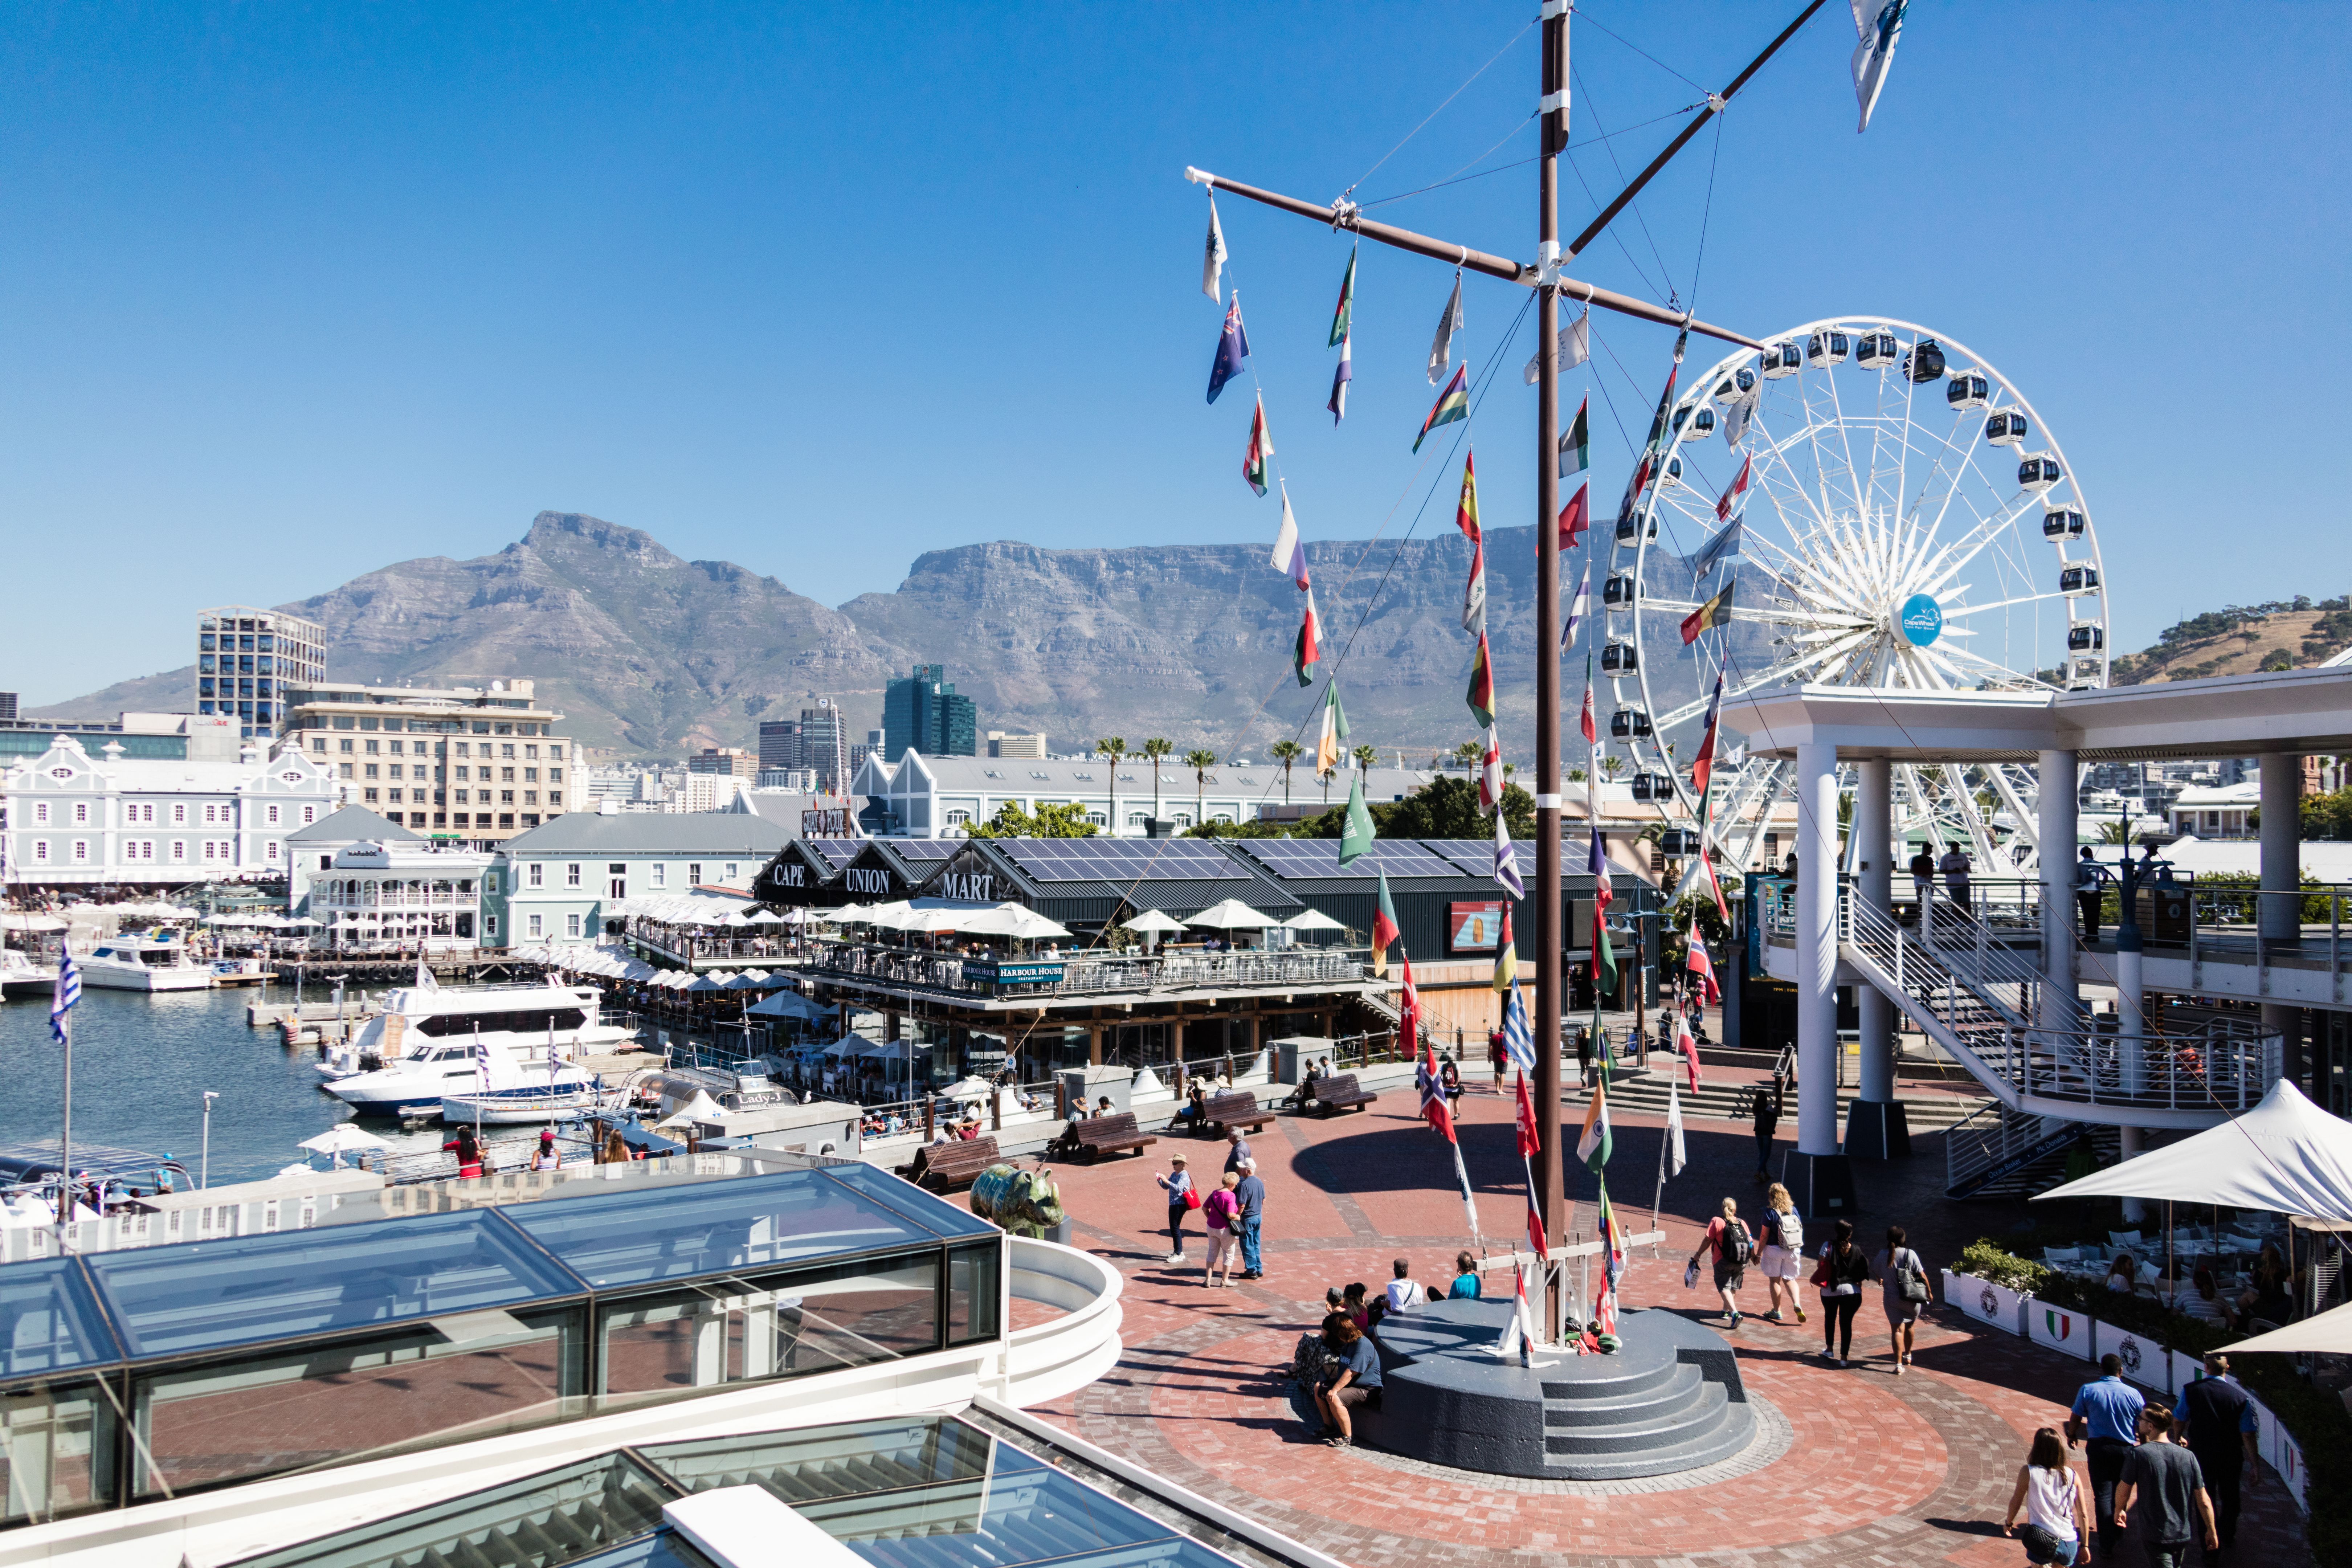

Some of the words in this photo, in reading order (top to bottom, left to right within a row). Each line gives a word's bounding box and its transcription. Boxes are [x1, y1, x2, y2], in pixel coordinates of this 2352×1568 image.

[1092, 752, 1135, 761] VICTRIA
[804, 811, 818, 832] QUAY
[826, 810, 844, 832] FOUR
[775, 864, 804, 887] CAPE
[846, 869, 890, 894] UNION
[942, 873, 993, 901] MART
[962, 965, 981, 974] HARBOUR
[982, 968, 996, 976] HOUSE
[737, 1093, 781, 1104] Lady-J
